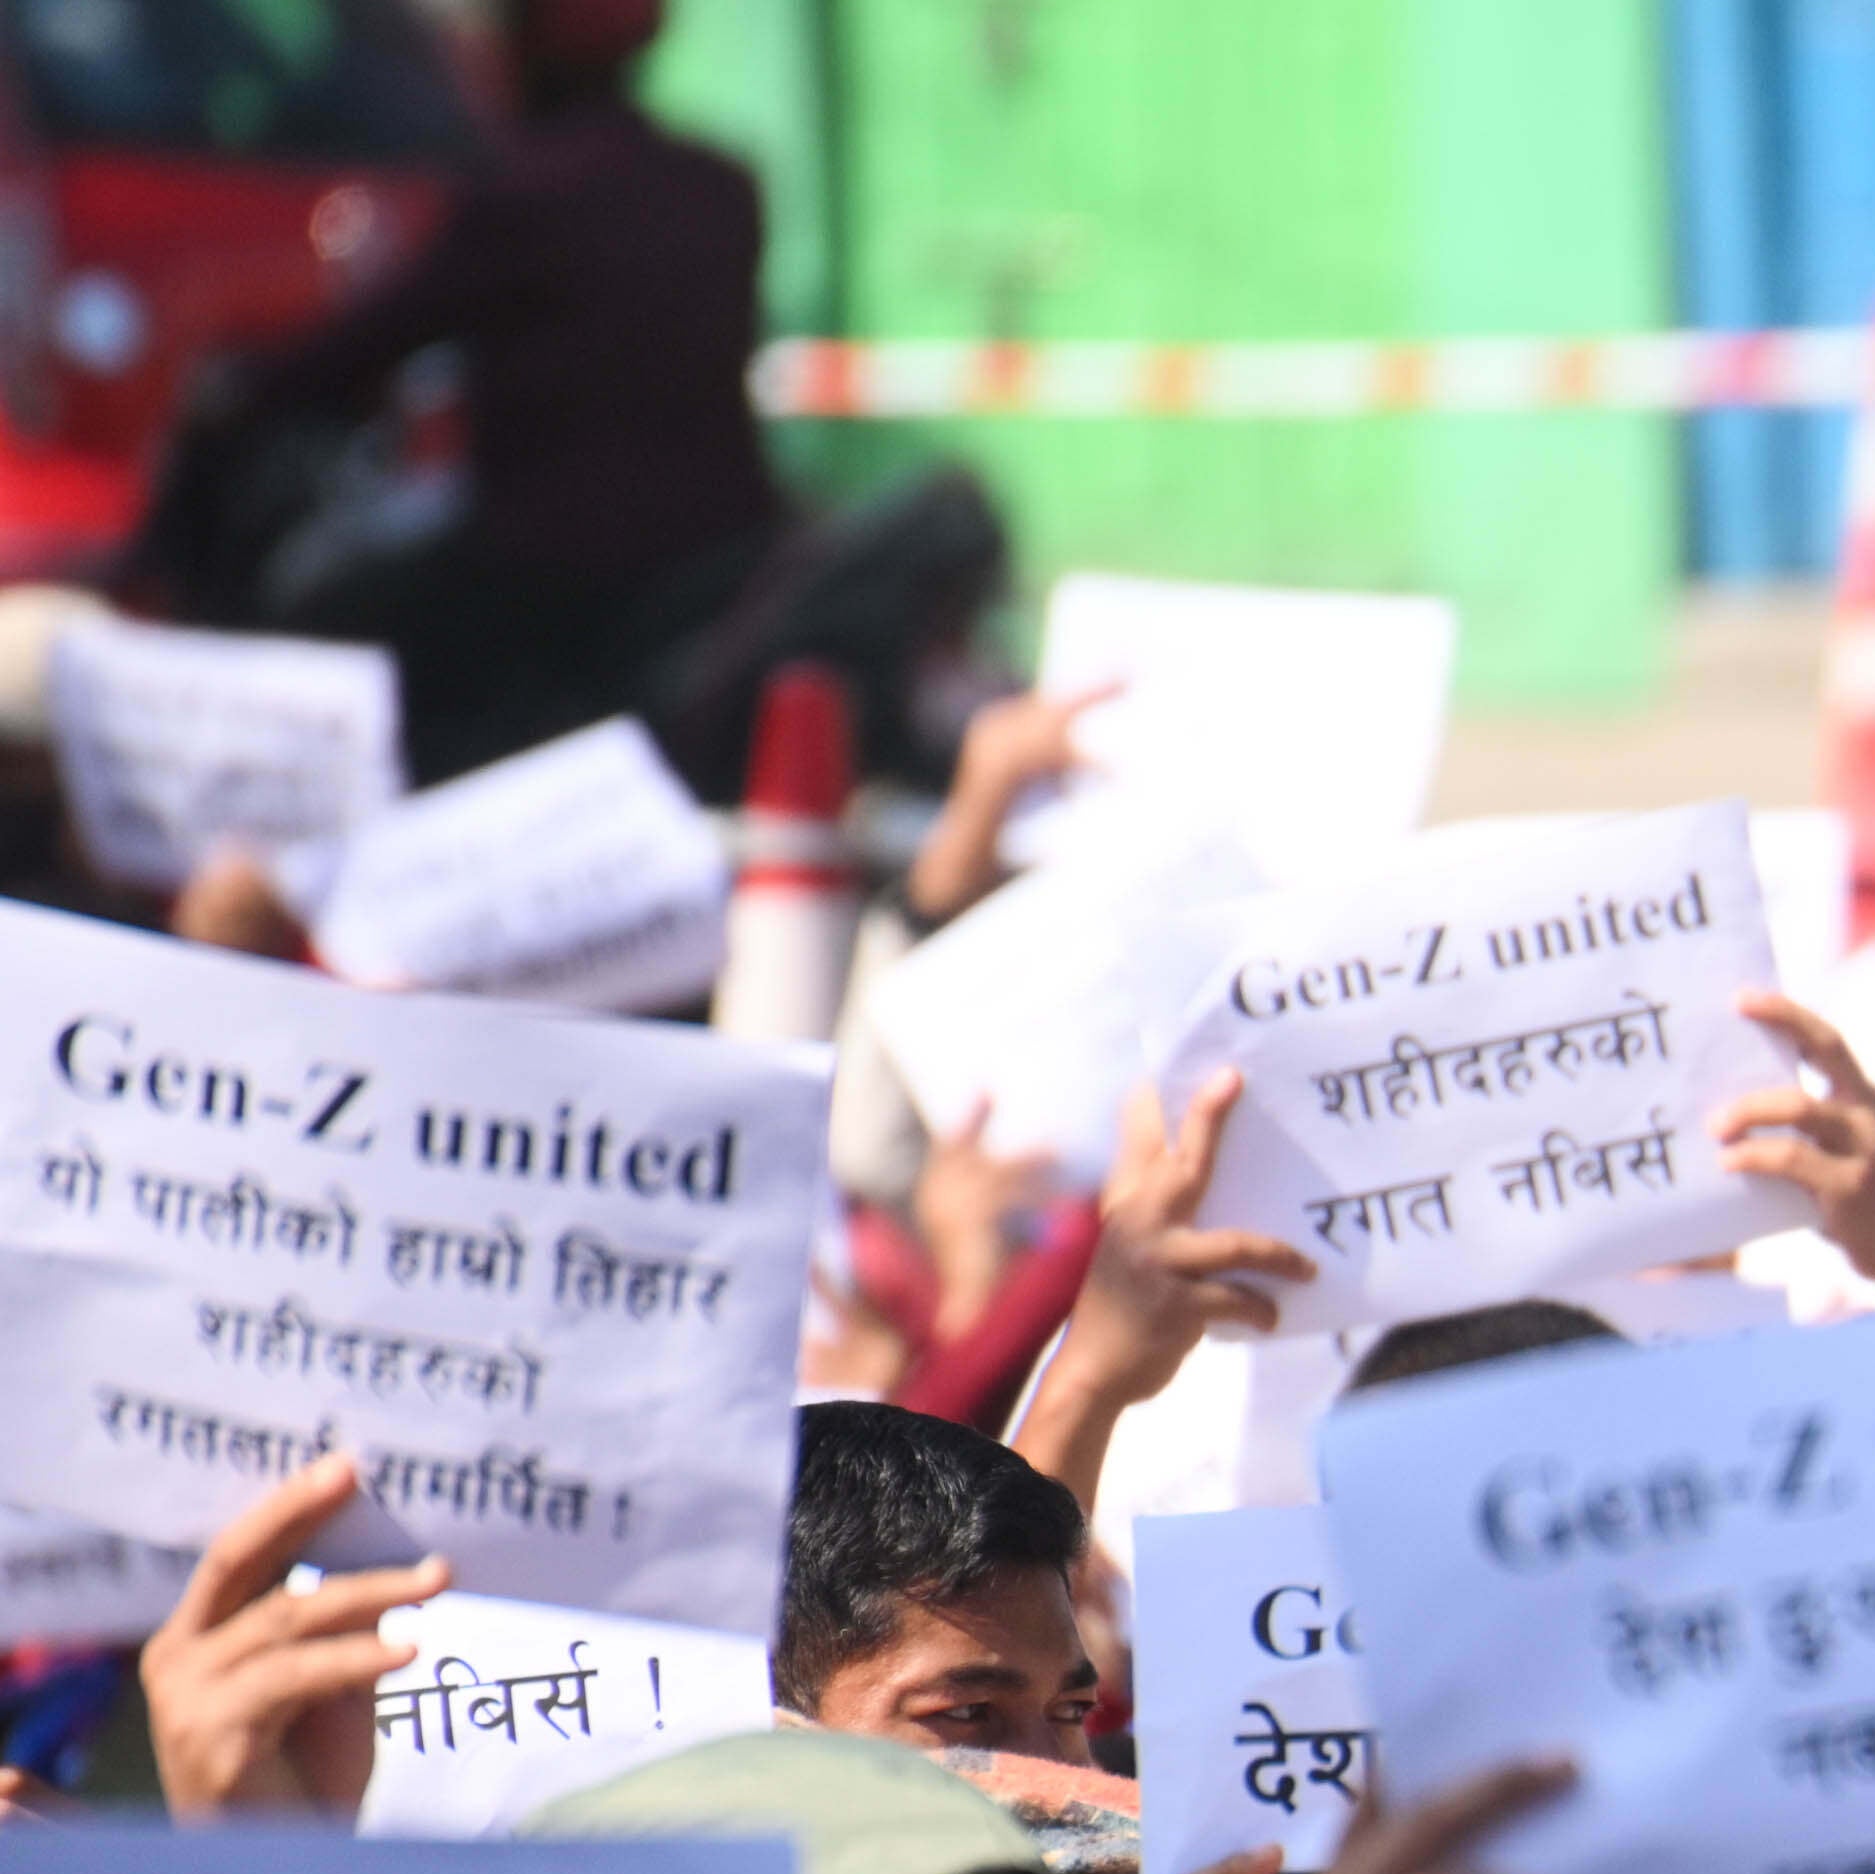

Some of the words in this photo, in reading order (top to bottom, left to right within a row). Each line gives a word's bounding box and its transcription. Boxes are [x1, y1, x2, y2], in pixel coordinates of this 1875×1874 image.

[1231, 924, 1463, 1022] Gen-Z
[1487, 872, 1713, 973] united
[53, 1014, 373, 1154] Gen-Z
[415, 1105, 738, 1203] united
[1311, 990, 1670, 1126] शहीदहरुको
[39, 1136, 104, 1214] यो
[550, 1225, 732, 1325] तिहार
[1303, 1174, 1453, 1260] रगत
[1490, 1107, 1677, 1213] नबिर्स
[1475, 1412, 1853, 1572] Gen-Z
[648, 1656, 667, 1730] !
